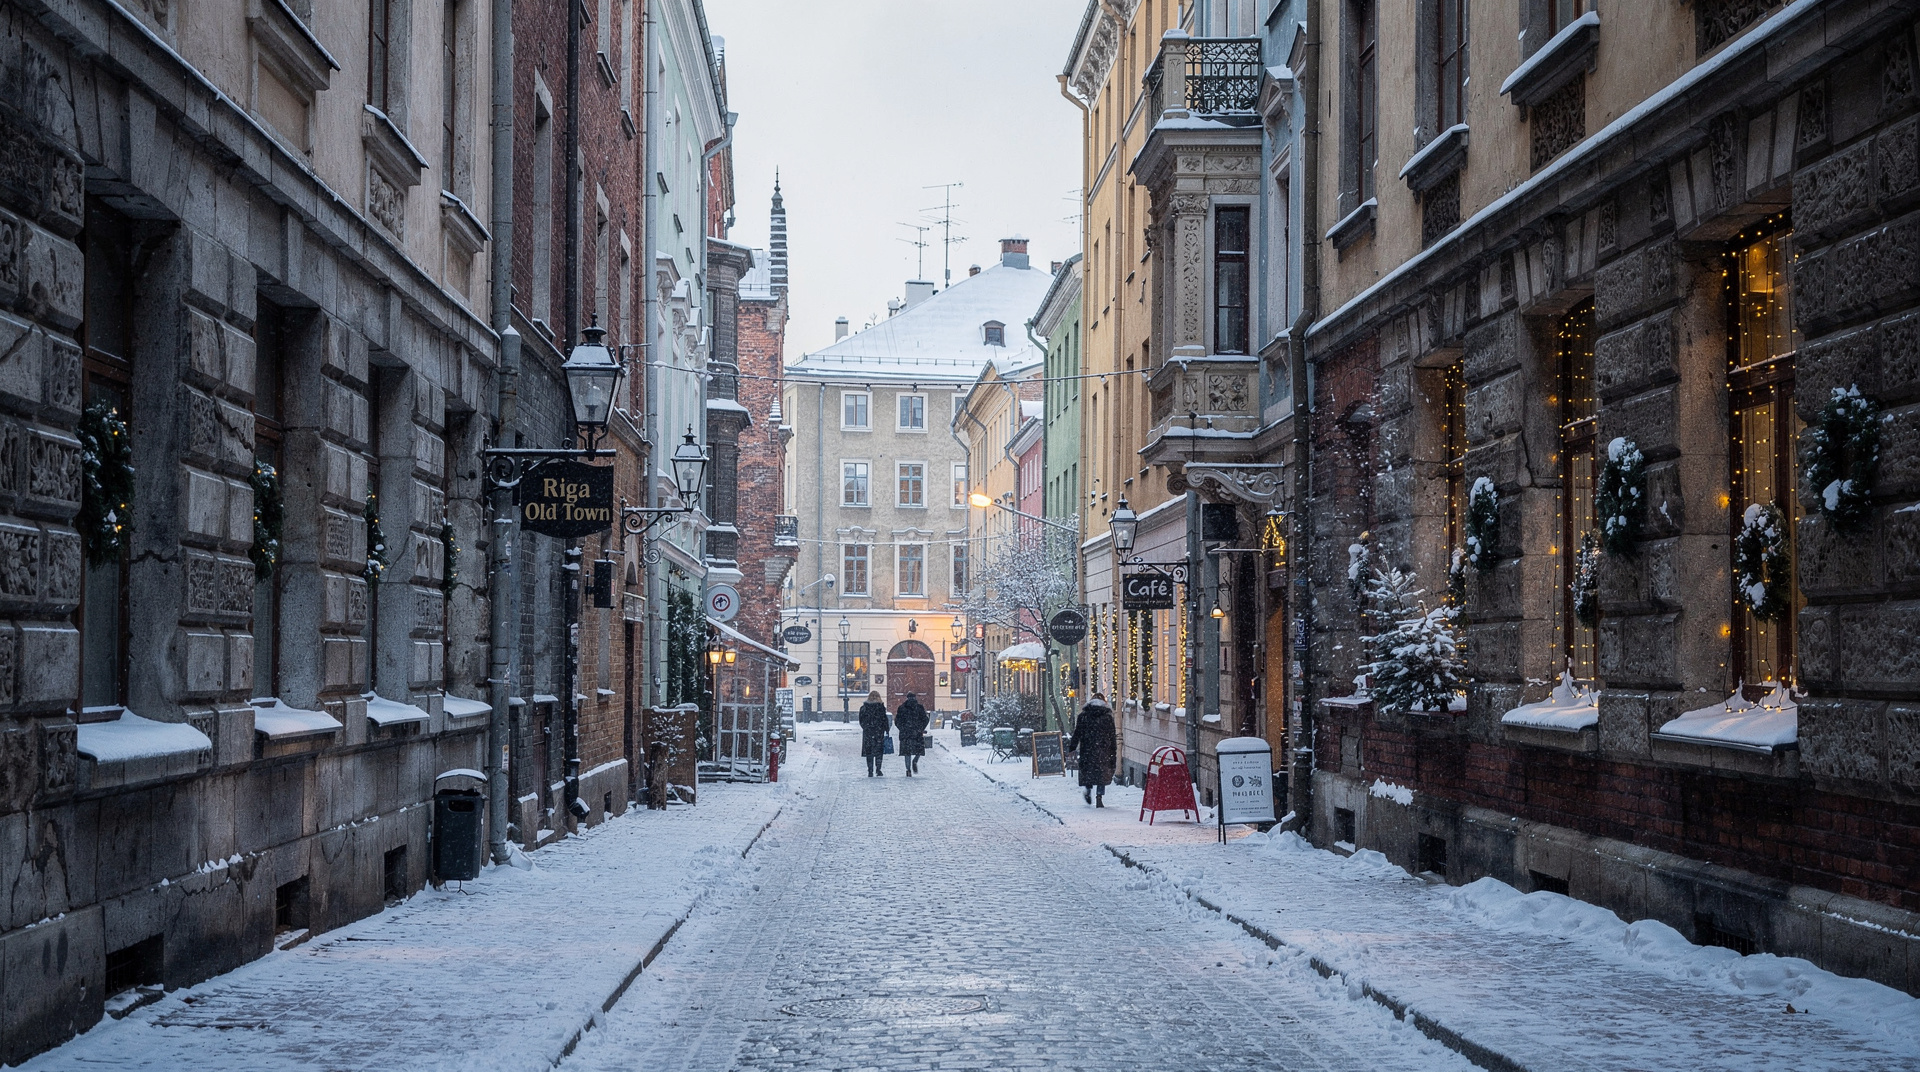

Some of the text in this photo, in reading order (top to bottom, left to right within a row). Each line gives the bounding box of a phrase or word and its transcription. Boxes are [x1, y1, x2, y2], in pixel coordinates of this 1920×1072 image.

[543, 478, 590, 503] Riga
[525, 502, 609, 521] Old Town
